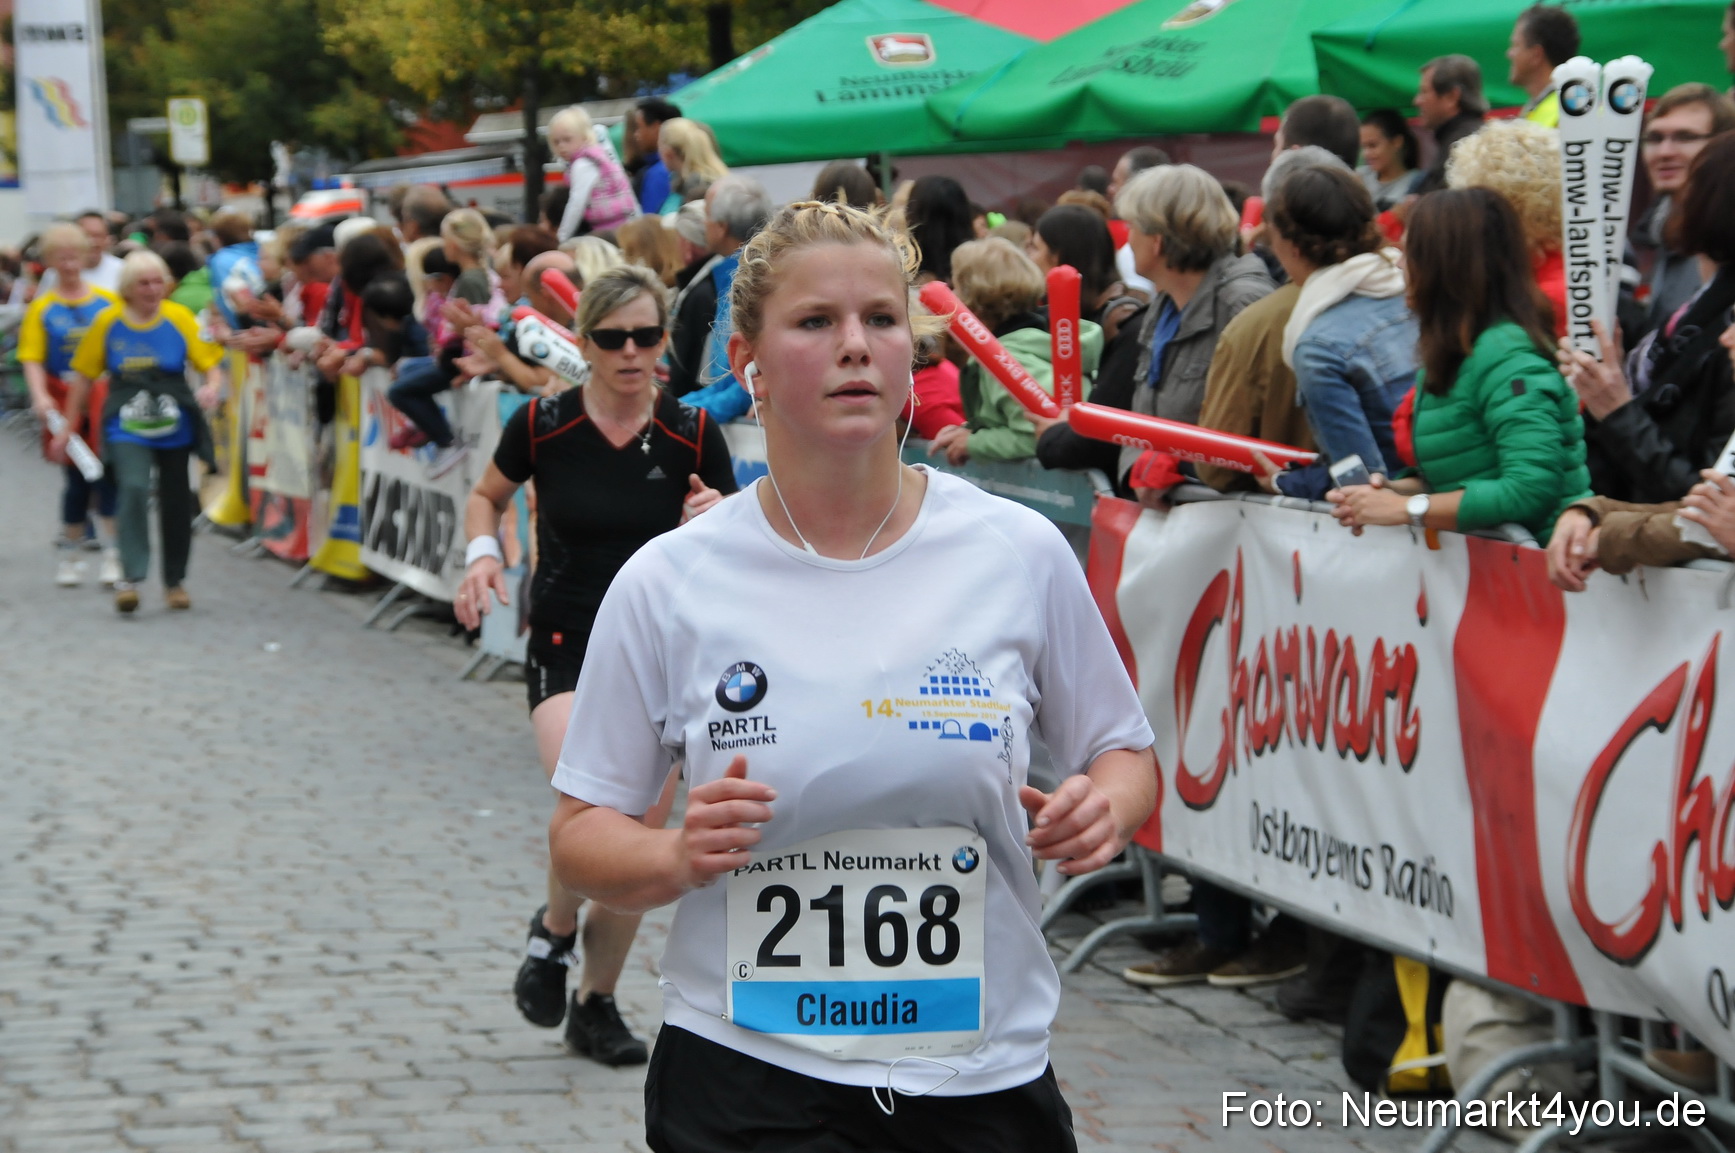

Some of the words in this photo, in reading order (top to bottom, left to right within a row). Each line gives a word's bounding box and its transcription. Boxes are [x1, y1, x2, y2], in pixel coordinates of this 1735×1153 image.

[556, 355, 589, 382] BM
[721, 663, 763, 683] BMW
[1174, 545, 1429, 812] Charivari
[861, 698, 902, 718] 14.
[895, 697, 967, 708] Neumarkter
[708, 715, 777, 738] PARTL
[711, 733, 777, 752] Neumarkt
[734, 853, 816, 877] PARTL
[824, 850, 941, 872] Neumarkt
[1380, 843, 1454, 919] Radio
[756, 884, 960, 968] 2168
[738, 964, 748, 979] C
[796, 993, 918, 1026] Claudia
